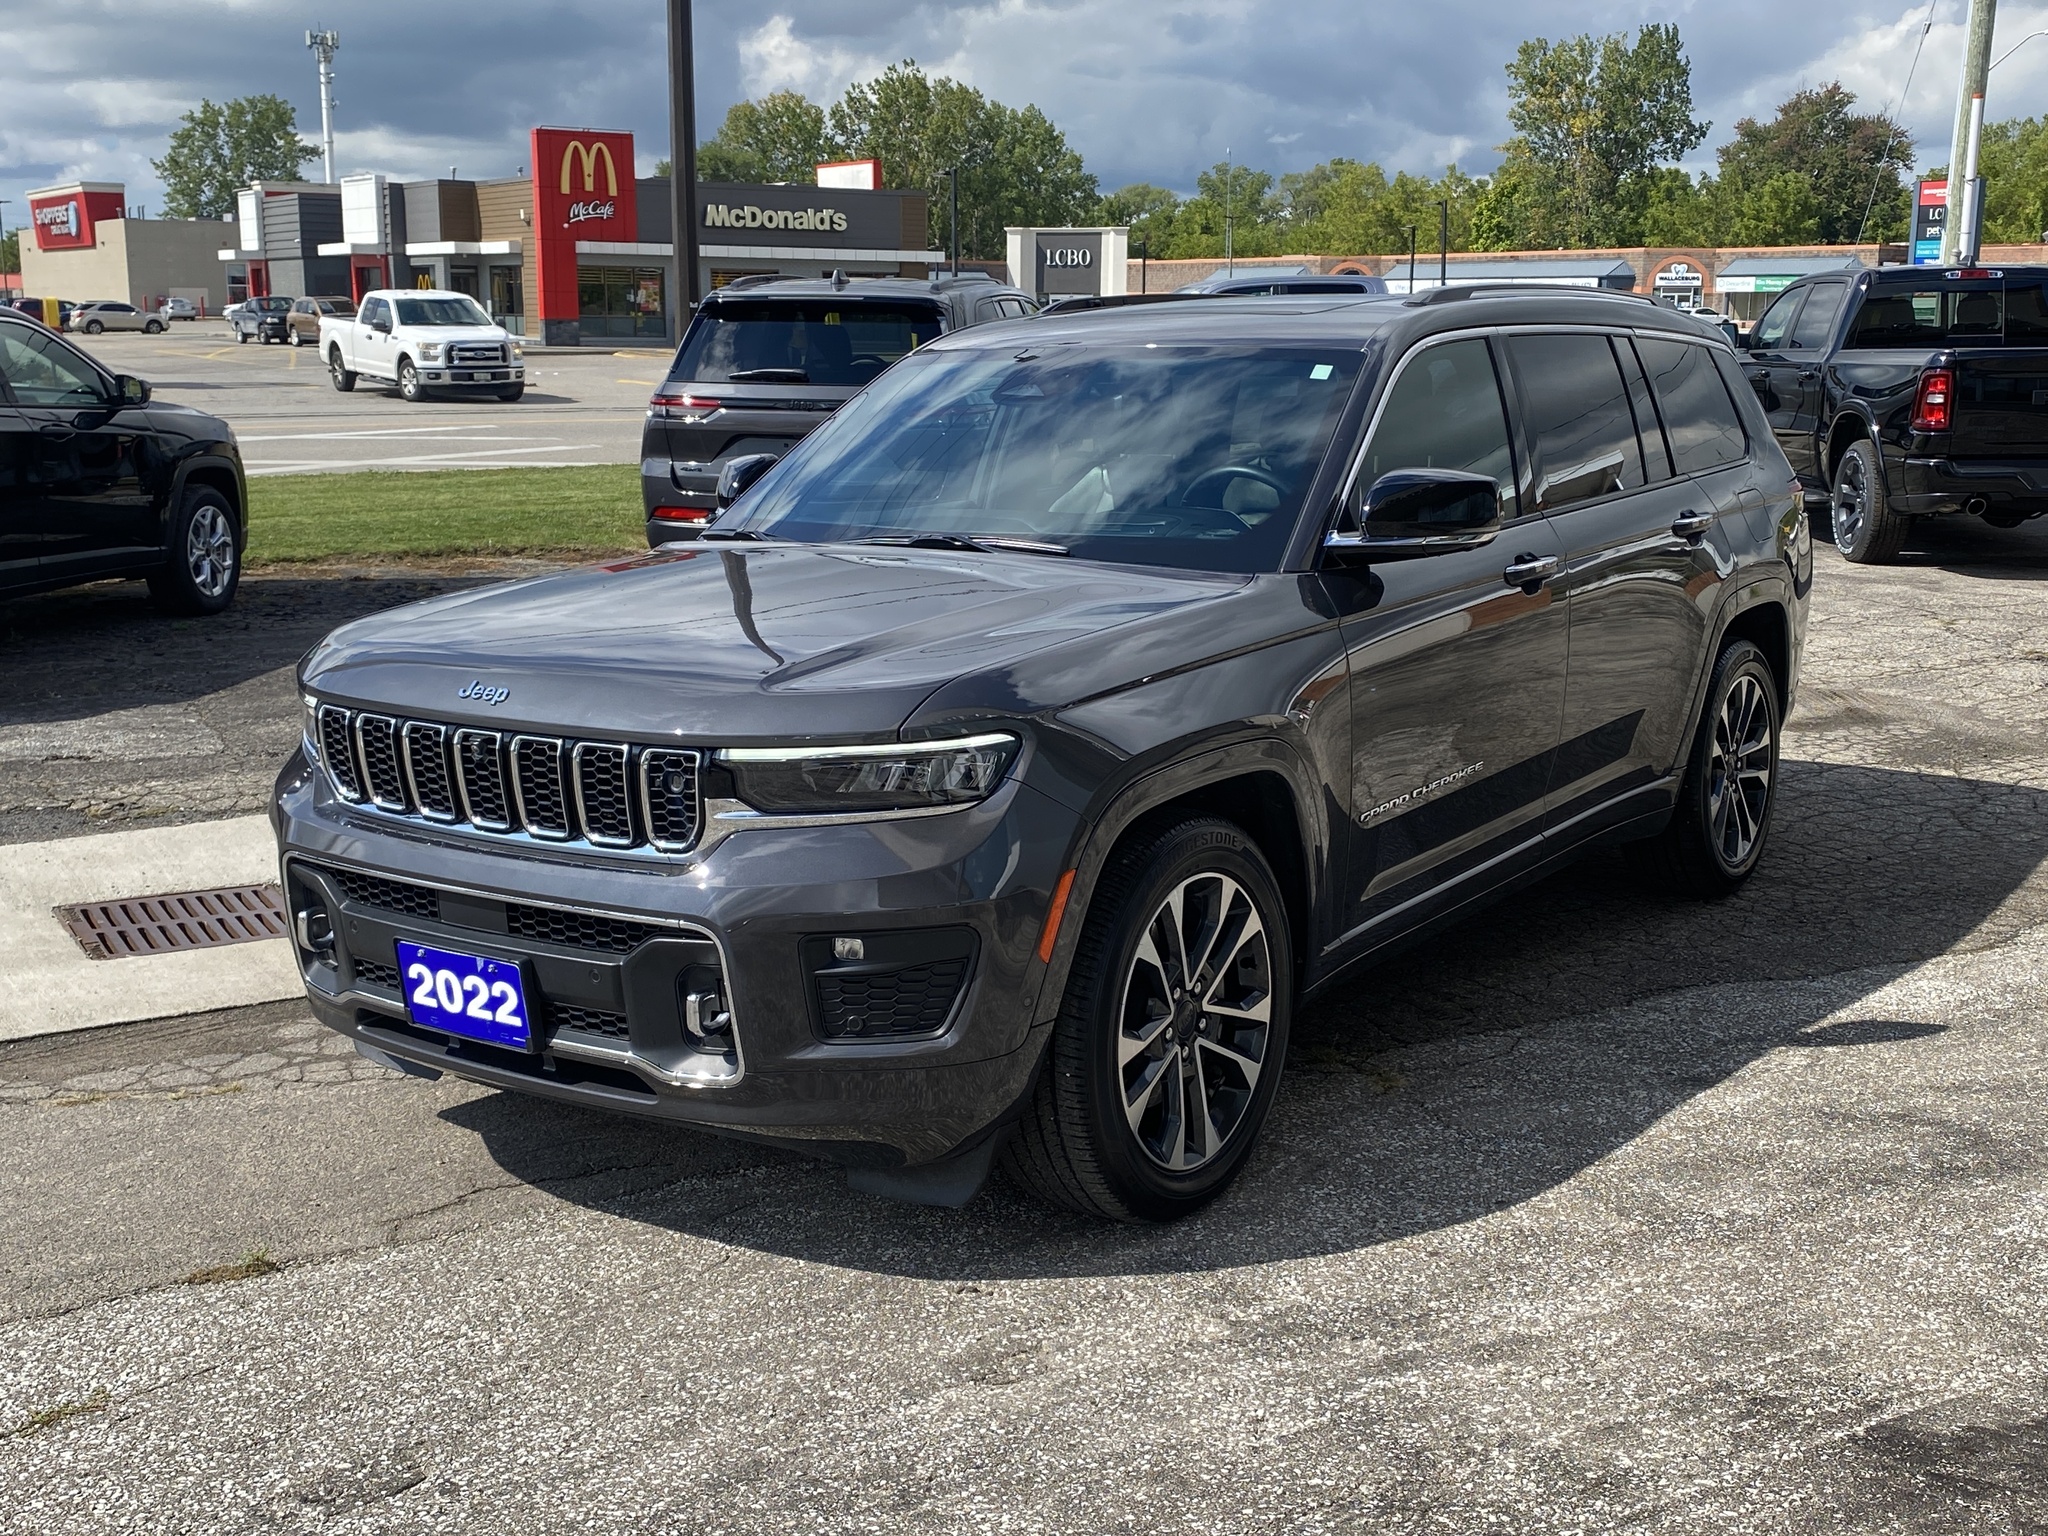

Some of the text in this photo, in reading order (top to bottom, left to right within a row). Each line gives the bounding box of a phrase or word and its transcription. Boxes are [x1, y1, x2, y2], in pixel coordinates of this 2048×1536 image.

[569, 200, 614, 222] McCafé
[705, 204, 848, 231] McDonald's
[1929, 208, 1944, 220] LC
[1046, 248, 1091, 266] LCBO
[458, 680, 510, 706] Jeep
[1360, 761, 1484, 822] GRAND CHEROKEE
[408, 963, 522, 1027] 2022
